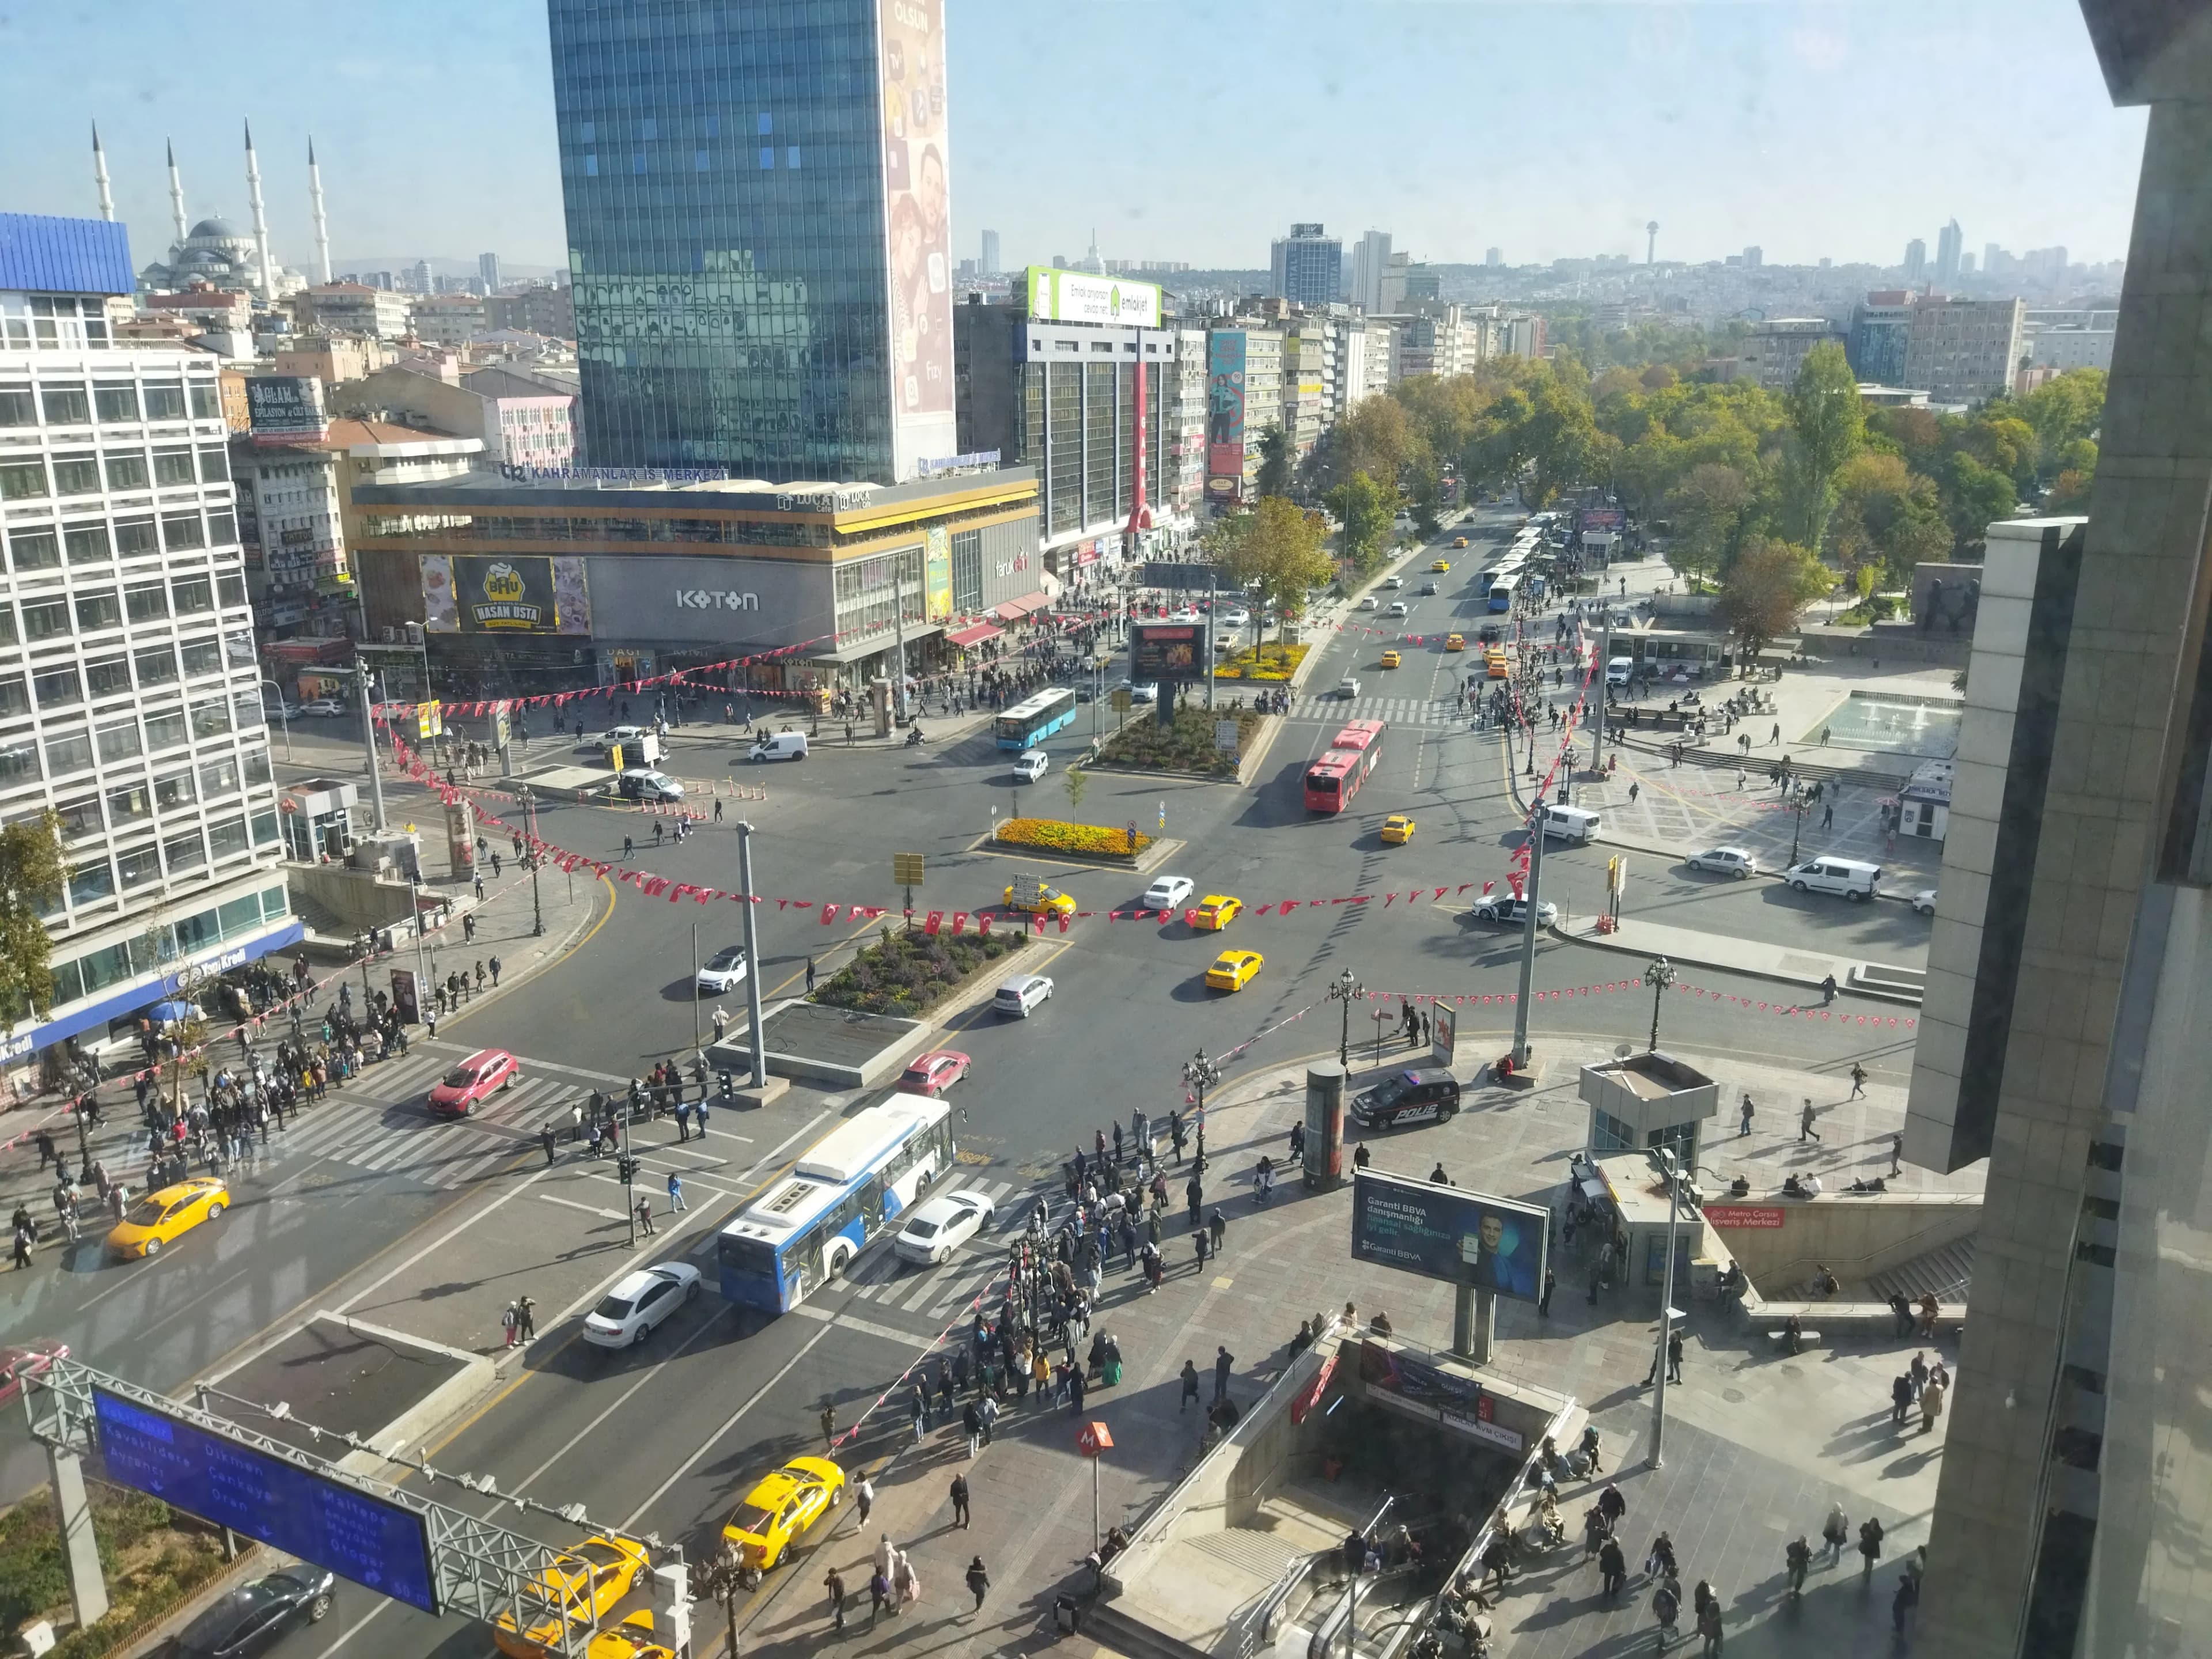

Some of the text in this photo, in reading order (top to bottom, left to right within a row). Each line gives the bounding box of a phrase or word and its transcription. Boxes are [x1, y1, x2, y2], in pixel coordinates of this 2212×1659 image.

[895, 1, 927, 33] OLSUN
[1071, 284, 1086, 298] Emlak
[1084, 304, 1098, 316] cevap
[1122, 294, 1147, 316] emlakjet
[926, 360, 942, 382] fizy
[265, 387, 291, 403] GLAM
[532, 467, 638, 480] KAHRAMANLAR
[664, 465, 726, 480] MERKEZİ
[797, 494, 832, 506] LOCA
[851, 490, 870, 503] LOCA
[676, 589, 759, 611] KOTON
[476, 607, 537, 621] HASAN USTA
[1368, 1196, 1426, 1217] Garanti BBVA
[1368, 1205, 1423, 1225] danışmanlığı
[1753, 1210, 1778, 1218] Çarşısı
[1366, 1223, 1400, 1237] iyi gelir.
[1368, 1213, 1451, 1240] finansal sağlığınıza
[1710, 1217, 1779, 1226] lışveriş Merkezi
[1370, 1244, 1422, 1262] Garanti BBVA
[1081, 1430, 1094, 1447] M
[1476, 1425, 1493, 1435] AVM
[1494, 1428, 1517, 1444] ÇIKIŞI
[212, 1488, 248, 1512] Oran
[323, 1488, 388, 1526] Maltepe
[325, 1508, 377, 1538] Anadolu
[331, 1539, 386, 1569] Otogar
[416, 1592, 429, 1605] m
